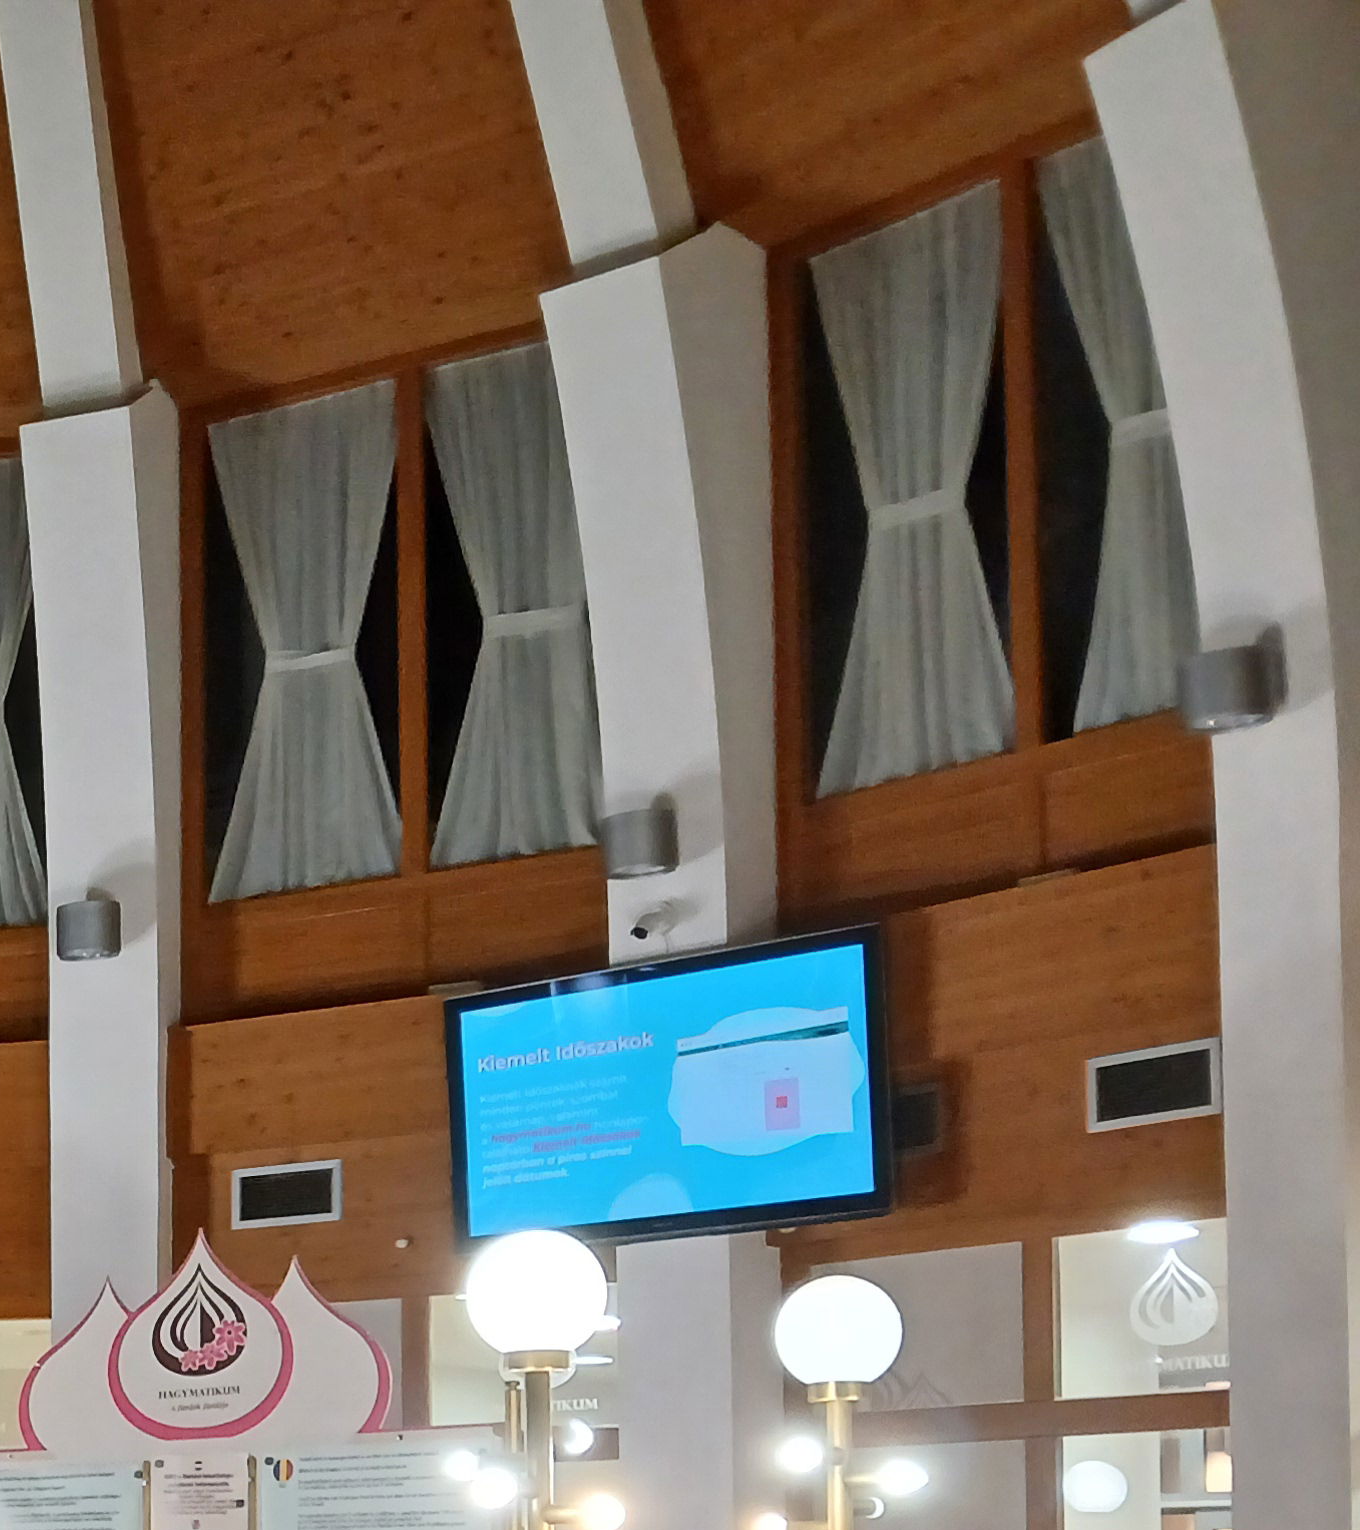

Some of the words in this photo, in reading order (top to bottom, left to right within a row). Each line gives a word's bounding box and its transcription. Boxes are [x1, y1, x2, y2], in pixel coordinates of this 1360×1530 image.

[477, 1048, 551, 1073] Kiemelt
[556, 1032, 654, 1061] Időszakok
[158, 1385, 241, 1400] HAGYMATIKUM
